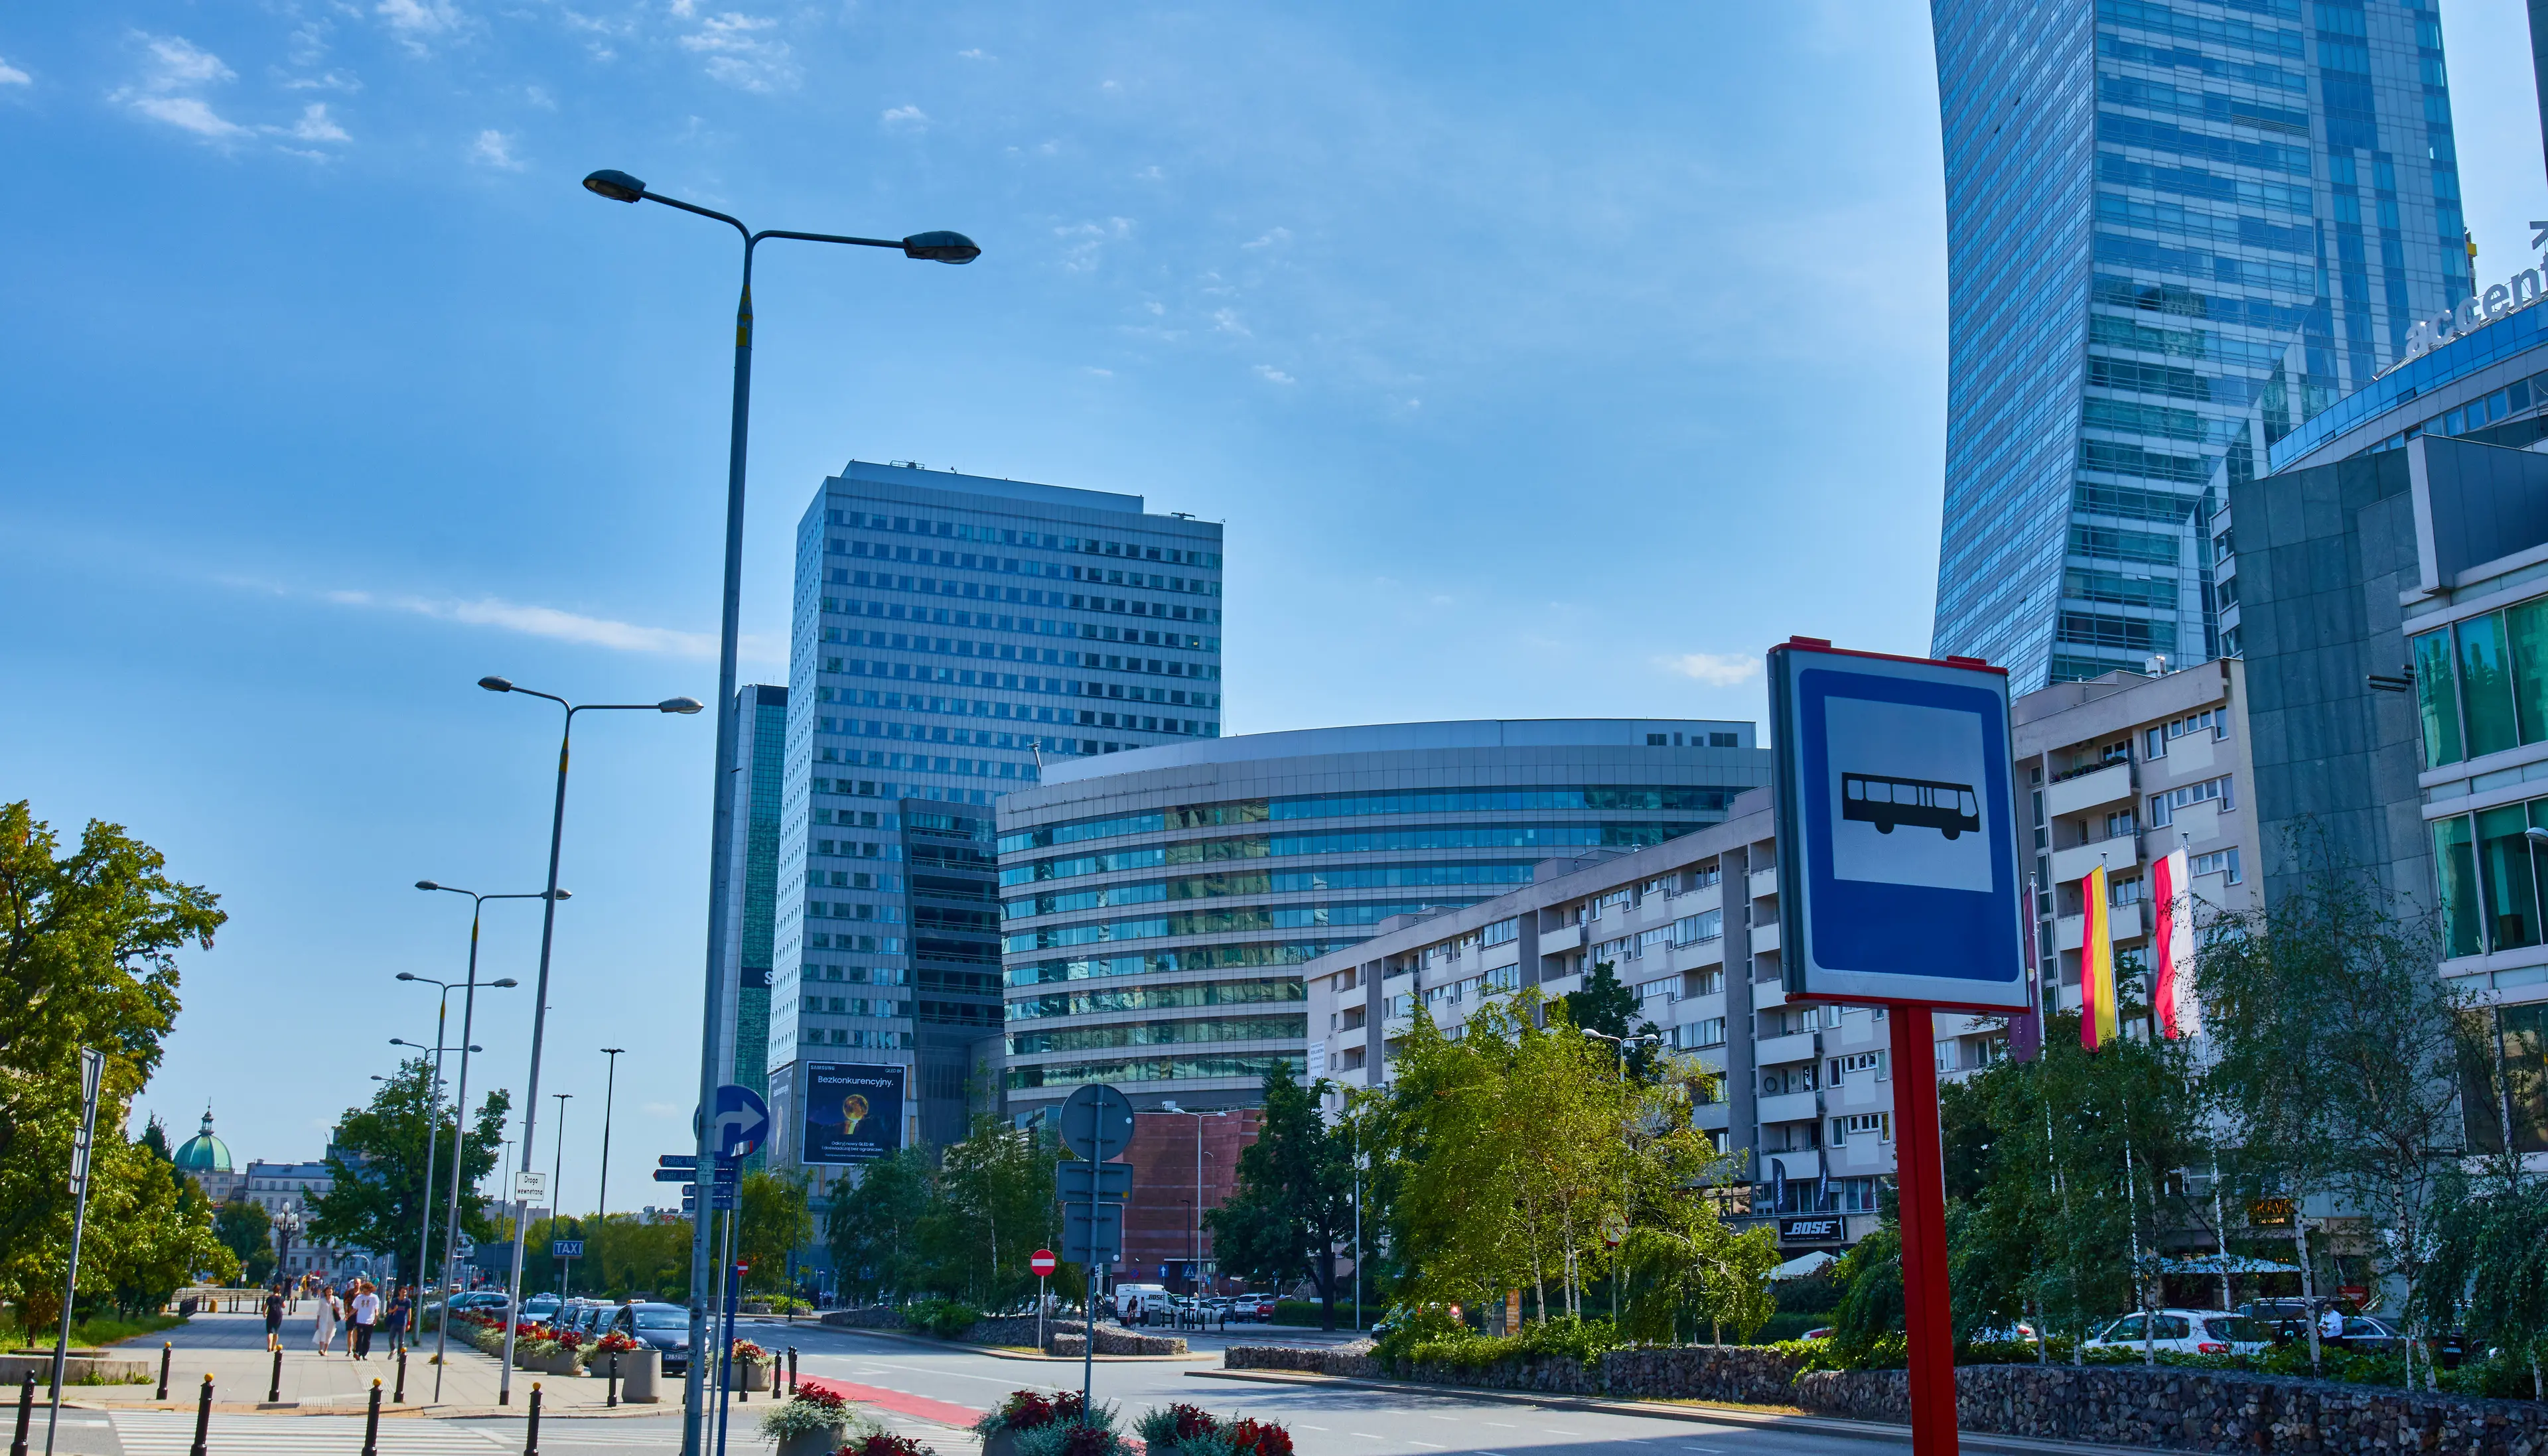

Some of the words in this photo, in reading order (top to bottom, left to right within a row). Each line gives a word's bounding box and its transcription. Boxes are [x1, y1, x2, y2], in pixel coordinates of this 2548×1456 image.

[818, 1076, 894, 1087] Bezkonkurencyjny.
[524, 1175, 538, 1186] Droga
[1785, 1221, 1837, 1234] BOSE
[555, 1242, 582, 1254] TAXI
